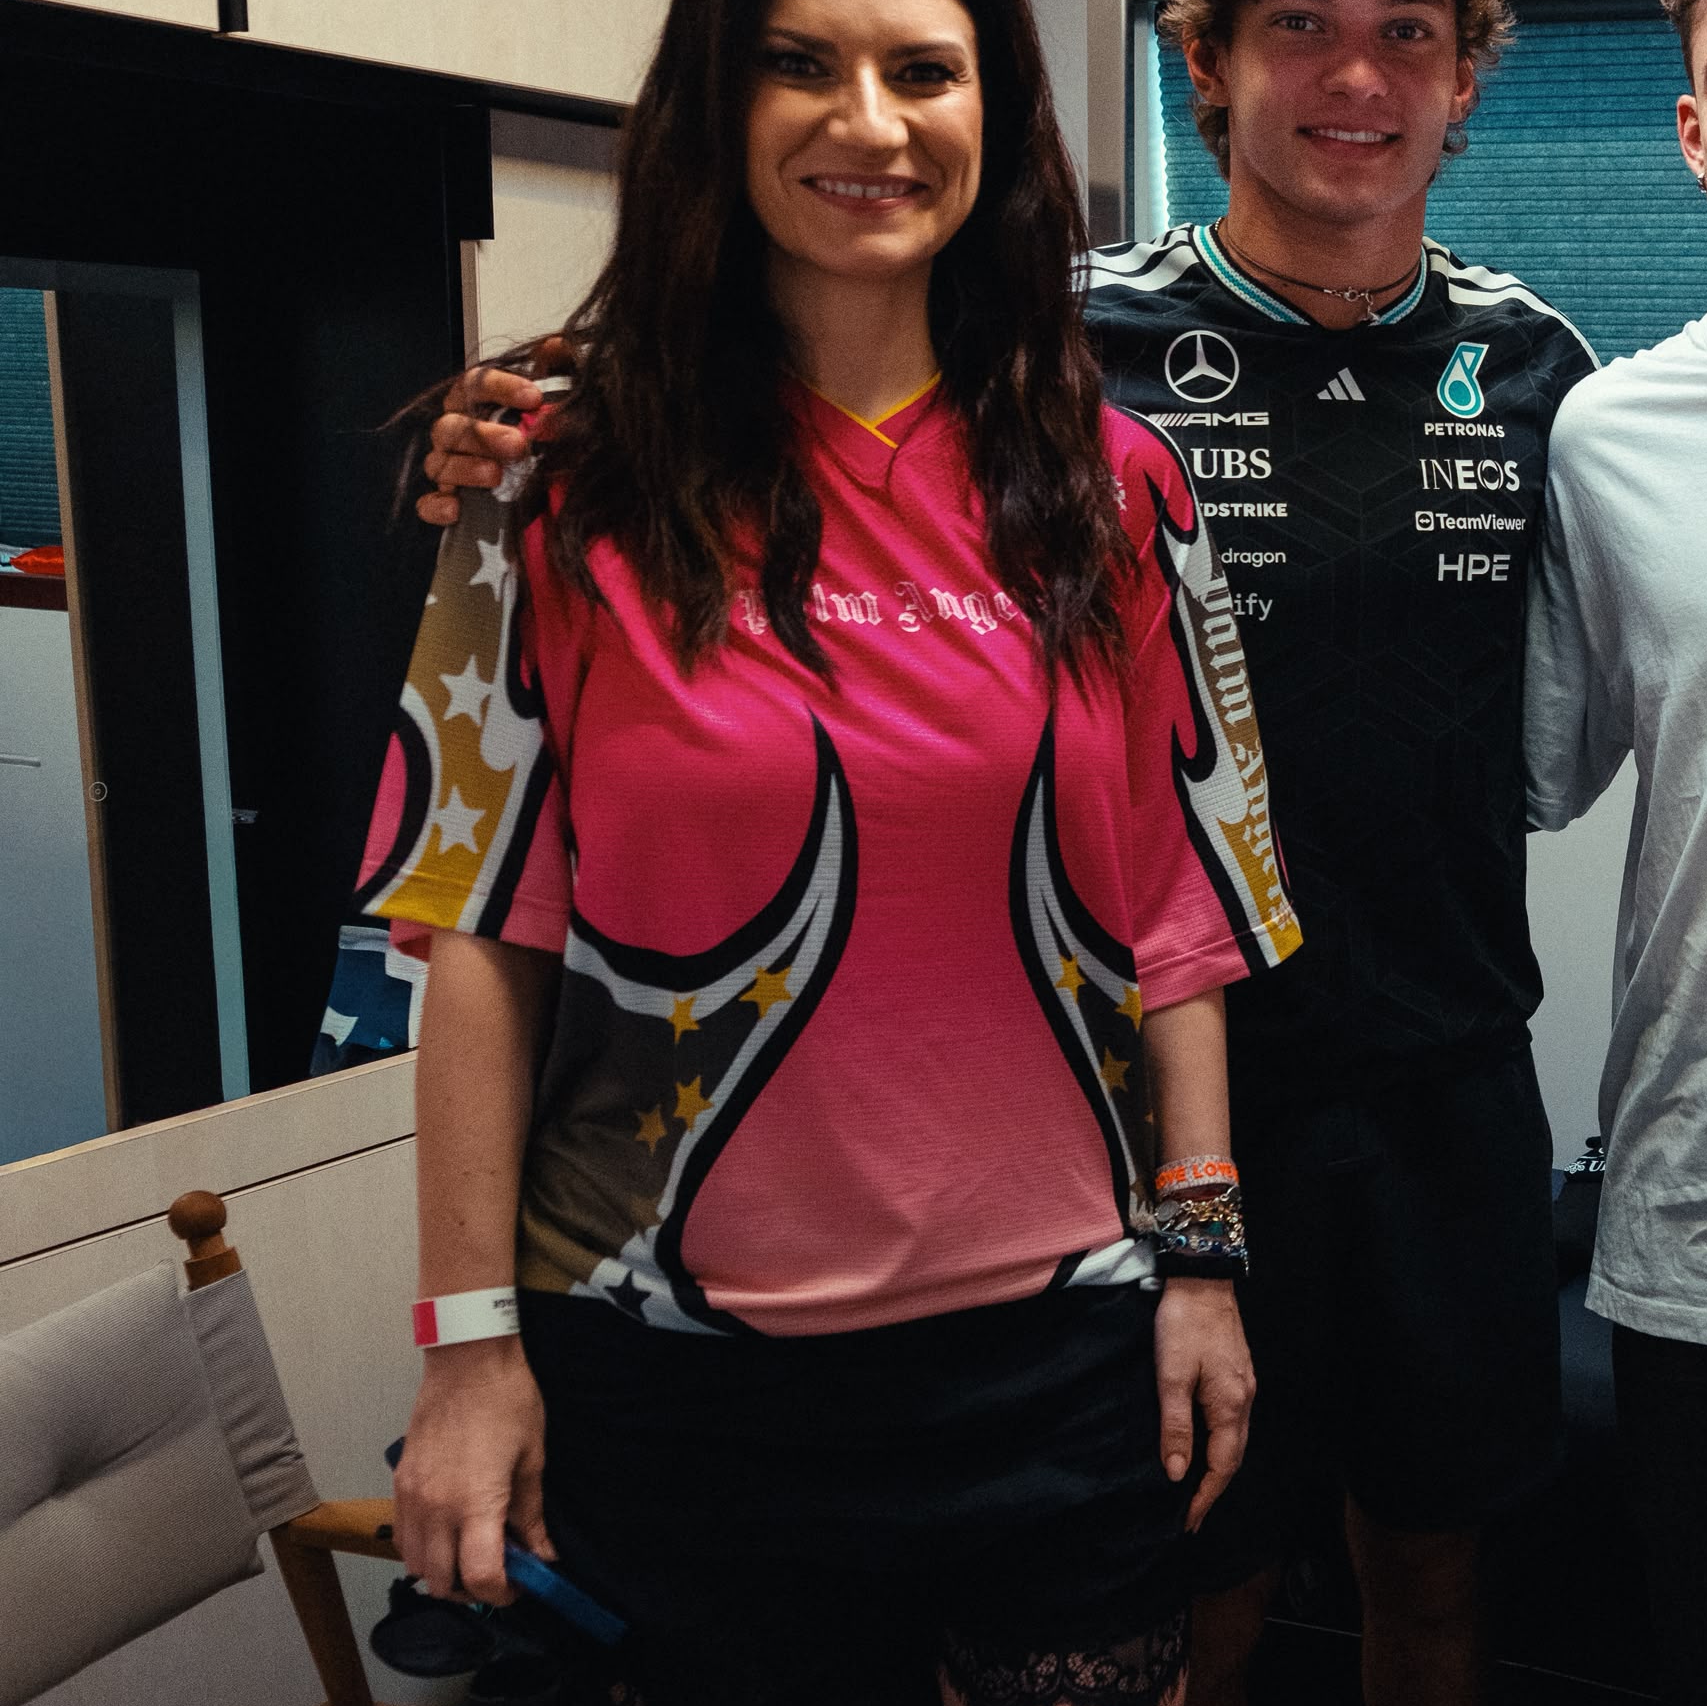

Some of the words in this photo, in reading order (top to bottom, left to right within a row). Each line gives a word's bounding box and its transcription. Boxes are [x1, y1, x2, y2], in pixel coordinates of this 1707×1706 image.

[1183, 412, 1270, 427] AMG
[1424, 422, 1506, 438] PETRONAS
[1190, 448, 1272, 480] UBS
[1419, 459, 1520, 492] INEOS
[1200, 503, 1288, 518] DSTRIKE
[1435, 512, 1526, 531] TeamViewer
[1218, 548, 1287, 568] dragon
[1437, 554, 1511, 582] HPE
[1234, 593, 1273, 621] ify
[1155, 1165, 1187, 1190] OVE
